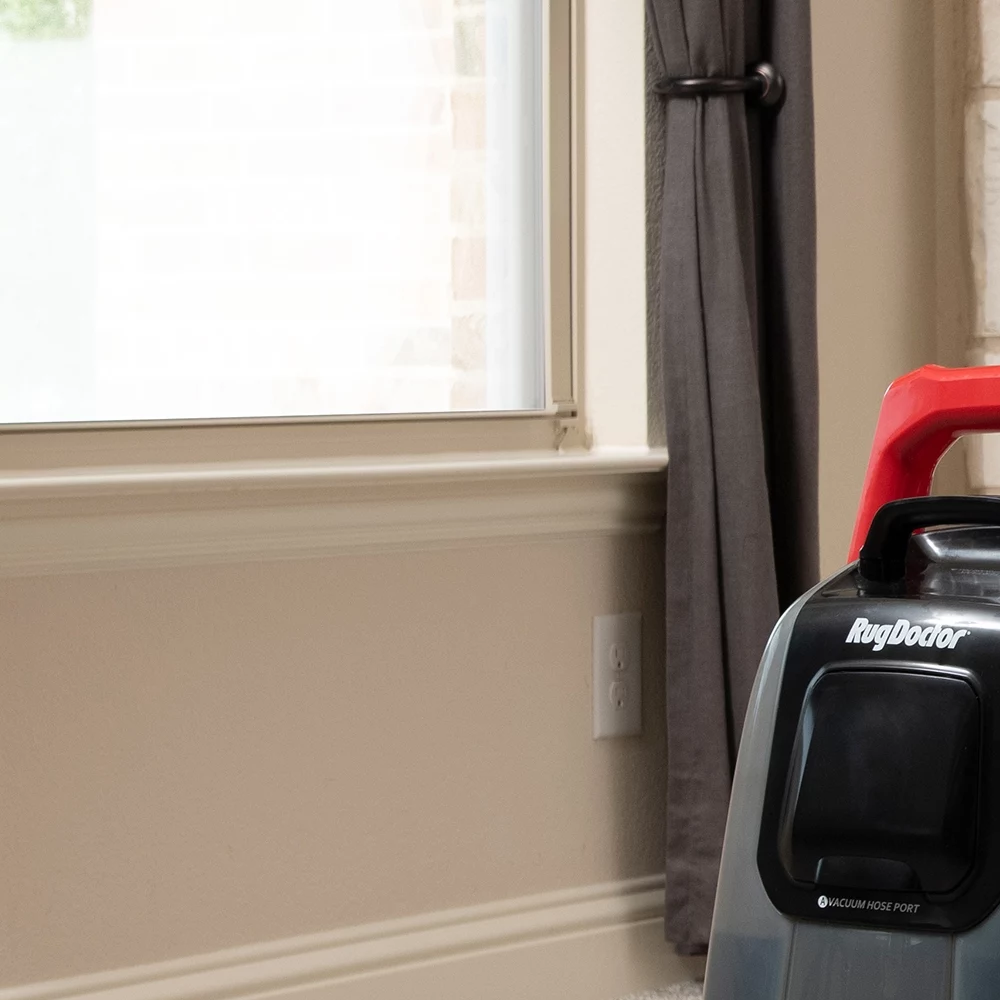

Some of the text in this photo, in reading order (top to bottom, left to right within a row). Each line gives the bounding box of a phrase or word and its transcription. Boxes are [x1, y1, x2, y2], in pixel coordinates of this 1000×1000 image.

[828, 897, 866, 909] VACUUM
[866, 900, 893, 912] HOSE
[893, 902, 920, 913] PORT
